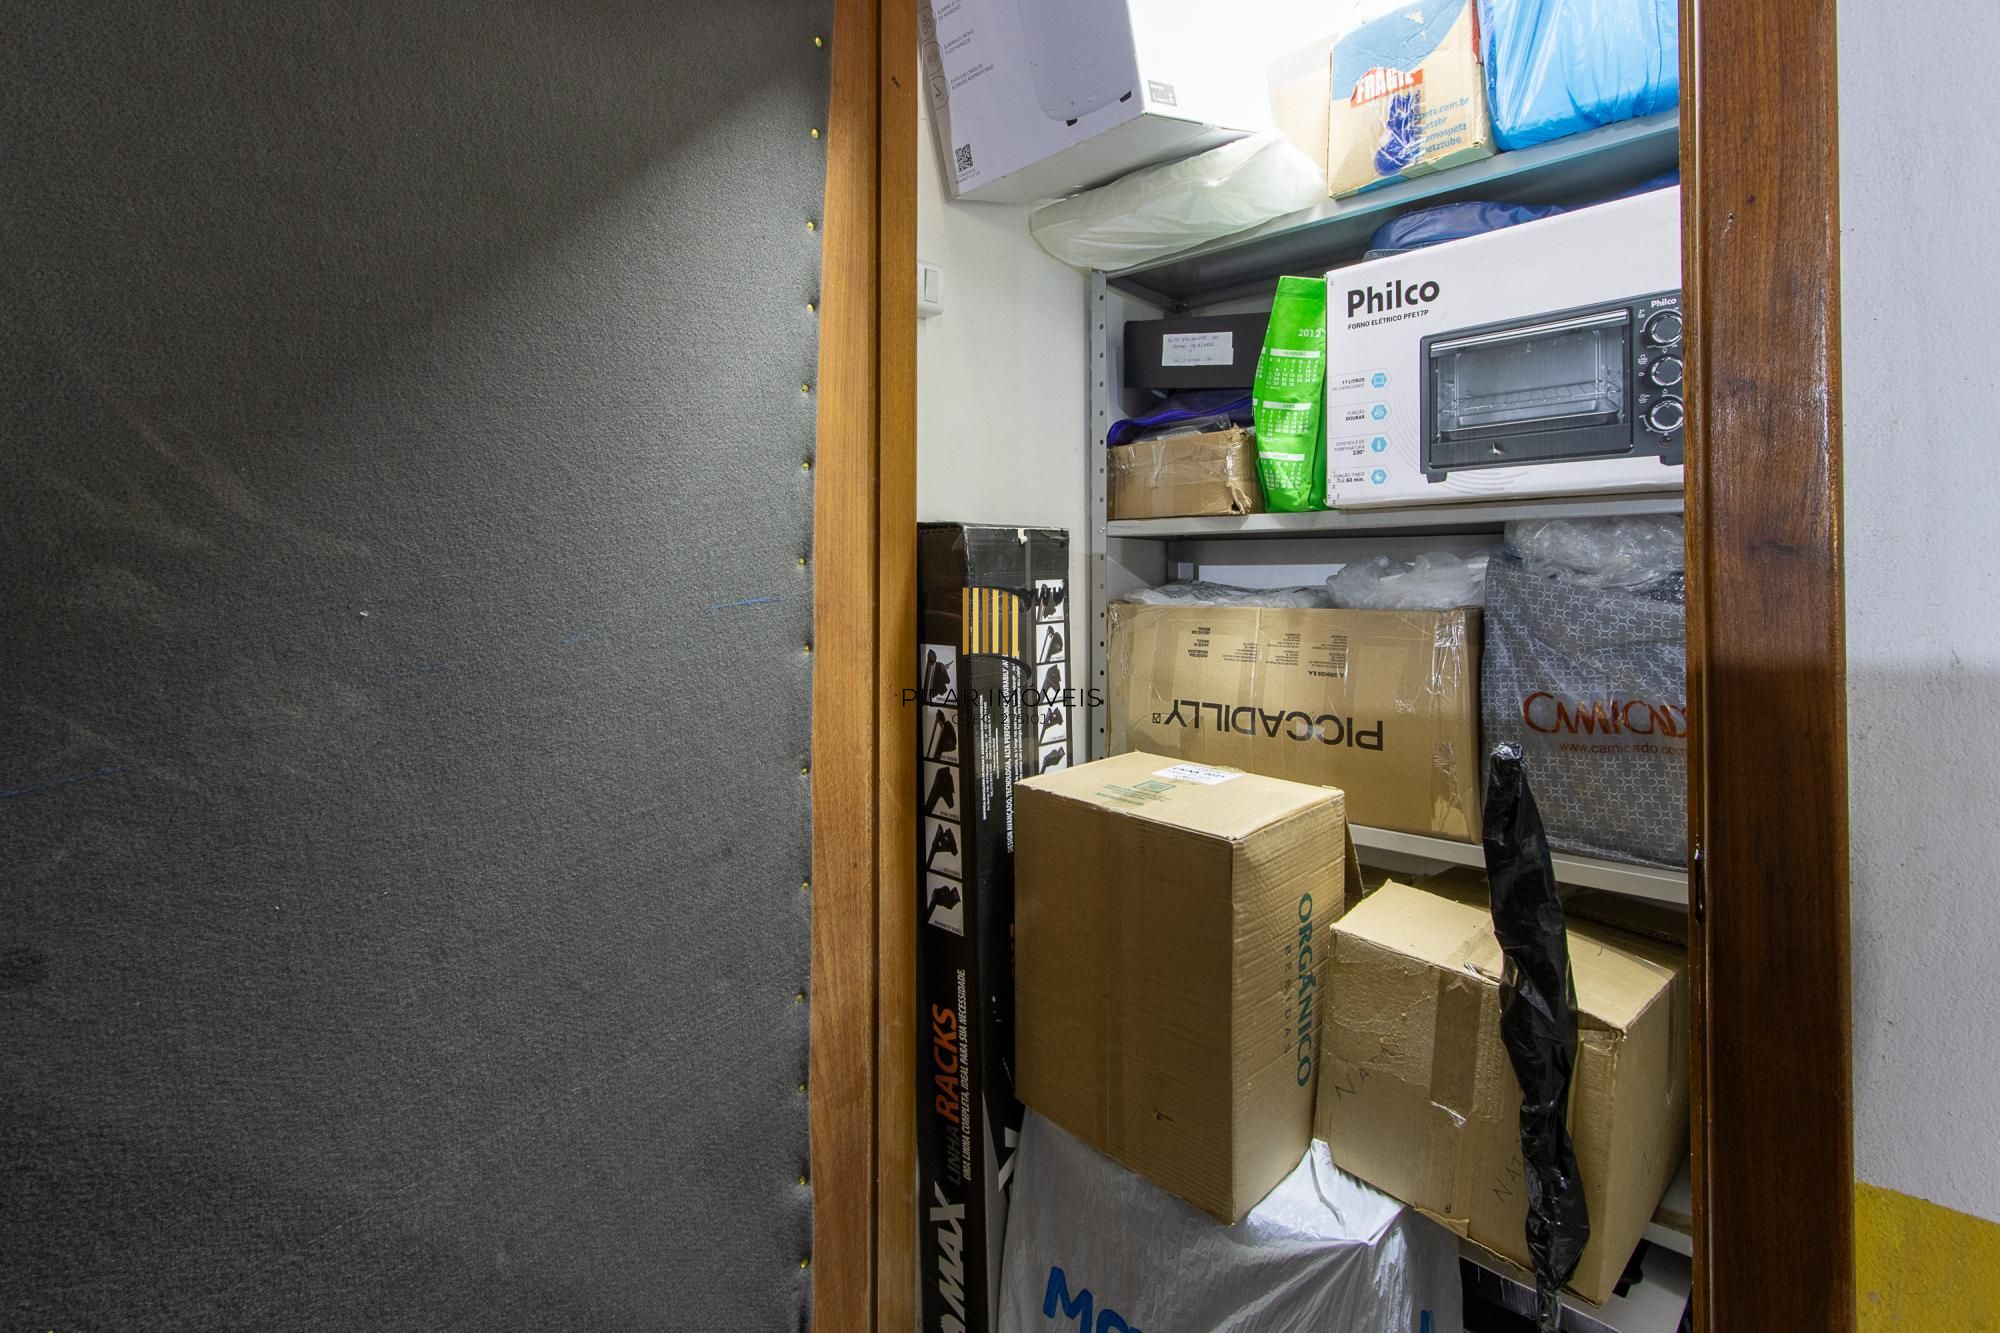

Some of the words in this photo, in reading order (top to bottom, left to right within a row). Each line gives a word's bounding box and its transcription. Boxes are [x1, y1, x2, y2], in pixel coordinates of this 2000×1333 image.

[1347, 279, 1440, 319] Philco
[1650, 297, 1677, 309] Philco
[1347, 320, 1370, 330] FORNO
[1371, 313, 1402, 327] ELÉTRICO
[1403, 309, 1429, 320] PFE17P
[1346, 414, 1365, 422] DOURAR
[1164, 698, 1384, 752] PICCADILLY
[1004, 758, 1012, 797] TECNOLOGIA,
[1005, 797, 1014, 831] AVANÇADO,
[1284, 943, 1292, 1055] BEBIDAS
[1298, 893, 1316, 1087] ORGÂNICO
[958, 1026, 968, 1041] SUA
[931, 1002, 959, 1124] RACKS
[959, 1043, 969, 1065] PARA
[959, 1066, 969, 1090] IDEAL
[960, 1091, 971, 1134] COMPLETA,
[946, 1125, 961, 1185] LINHA
[961, 1134, 971, 1161] LINHA
[962, 1160, 972, 1181] UMA
